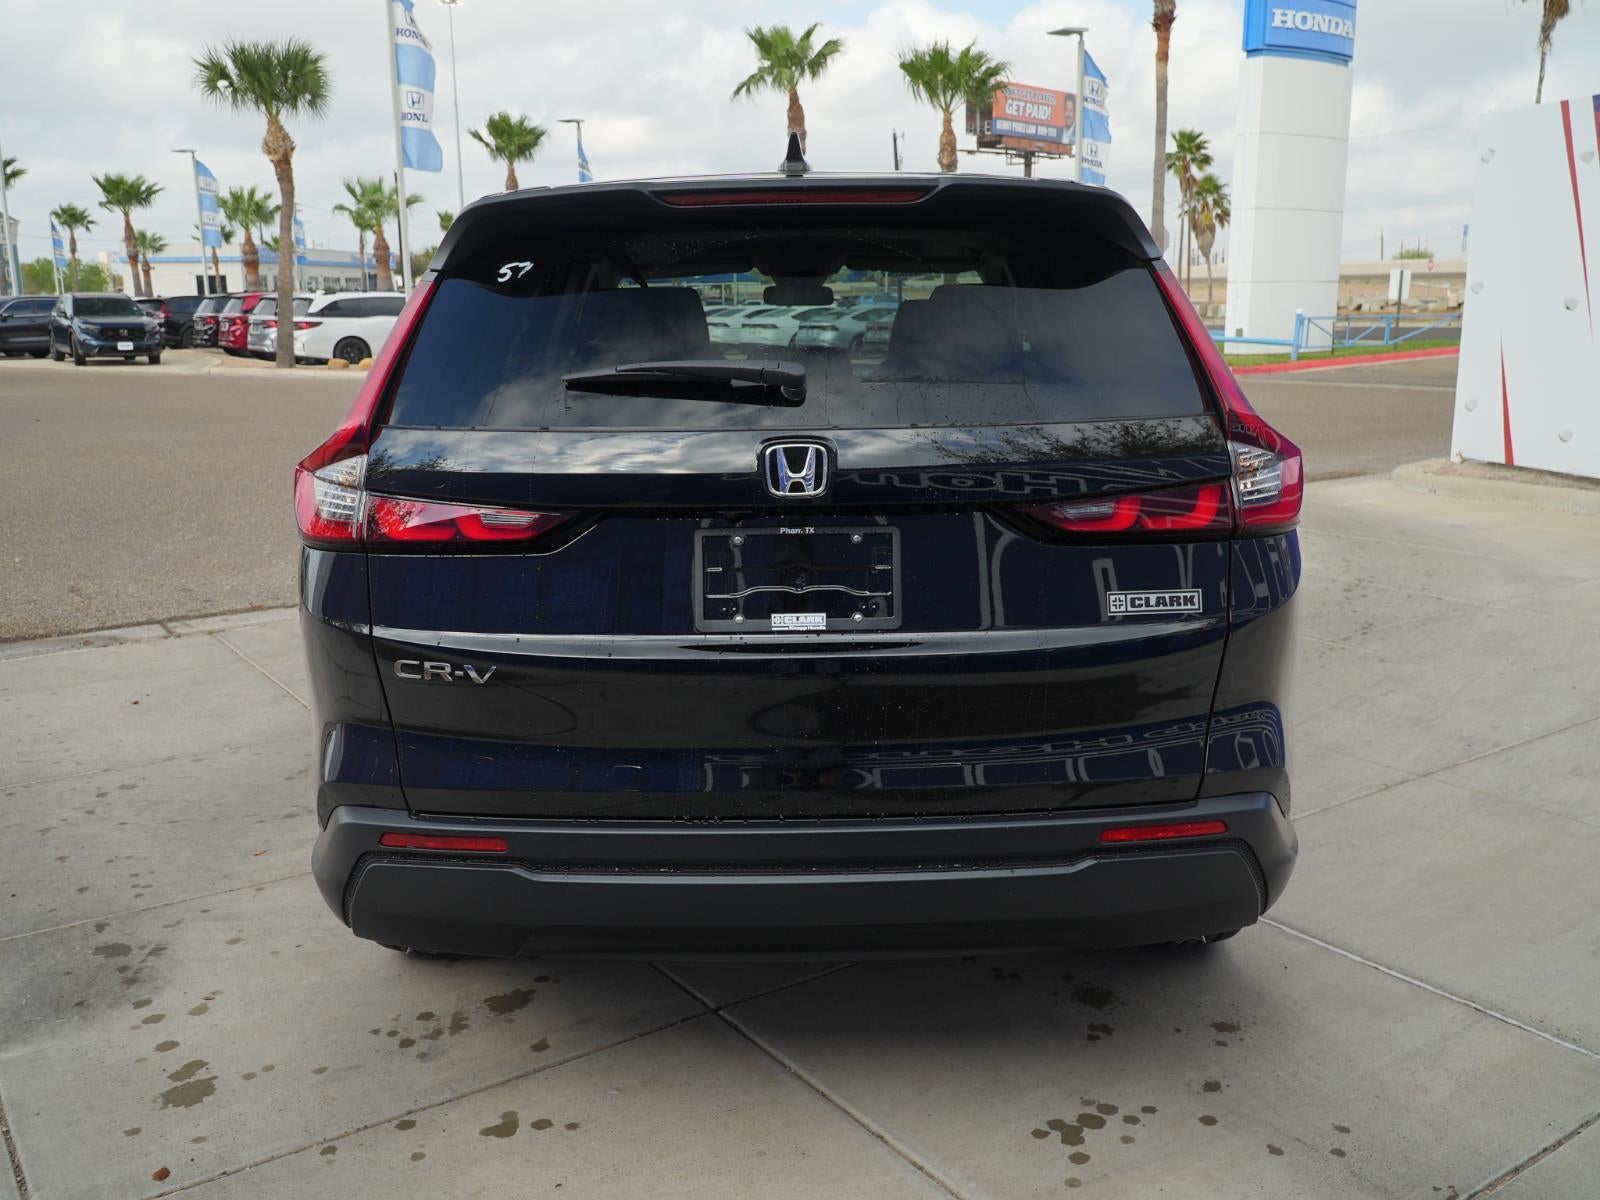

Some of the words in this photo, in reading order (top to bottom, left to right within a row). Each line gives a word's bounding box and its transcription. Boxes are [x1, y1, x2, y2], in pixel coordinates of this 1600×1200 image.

[1272, 8, 1355, 40] HONDA
[1006, 99, 1024, 116] GET
[1026, 103, 1051, 121] PAID!
[497, 261, 534, 282] 57
[1130, 595, 1196, 608] CLARK
[784, 616, 824, 624] CLARK
[394, 660, 496, 684] CR-V
